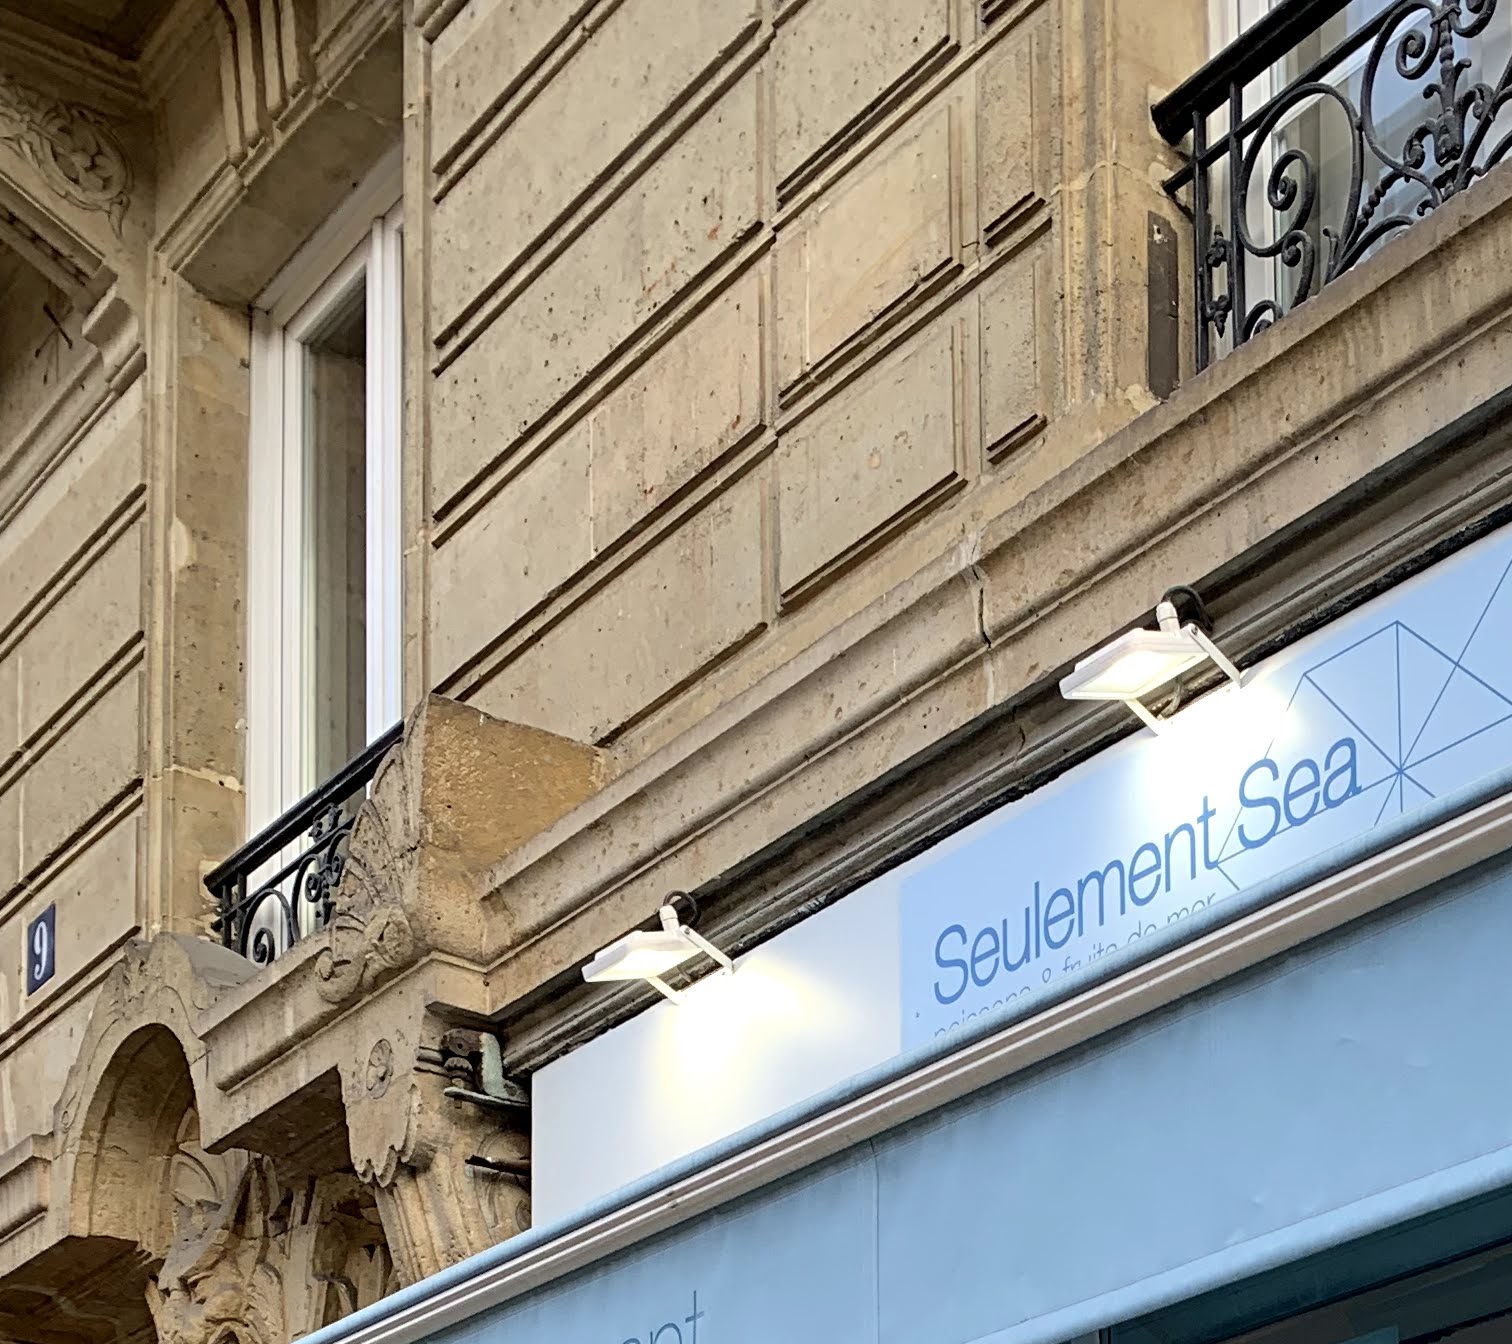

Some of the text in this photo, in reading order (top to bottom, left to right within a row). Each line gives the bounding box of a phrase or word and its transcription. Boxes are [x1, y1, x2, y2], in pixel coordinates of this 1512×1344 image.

[34, 921, 48, 981] 9
[934, 737, 1362, 1005] Seulement Sea
